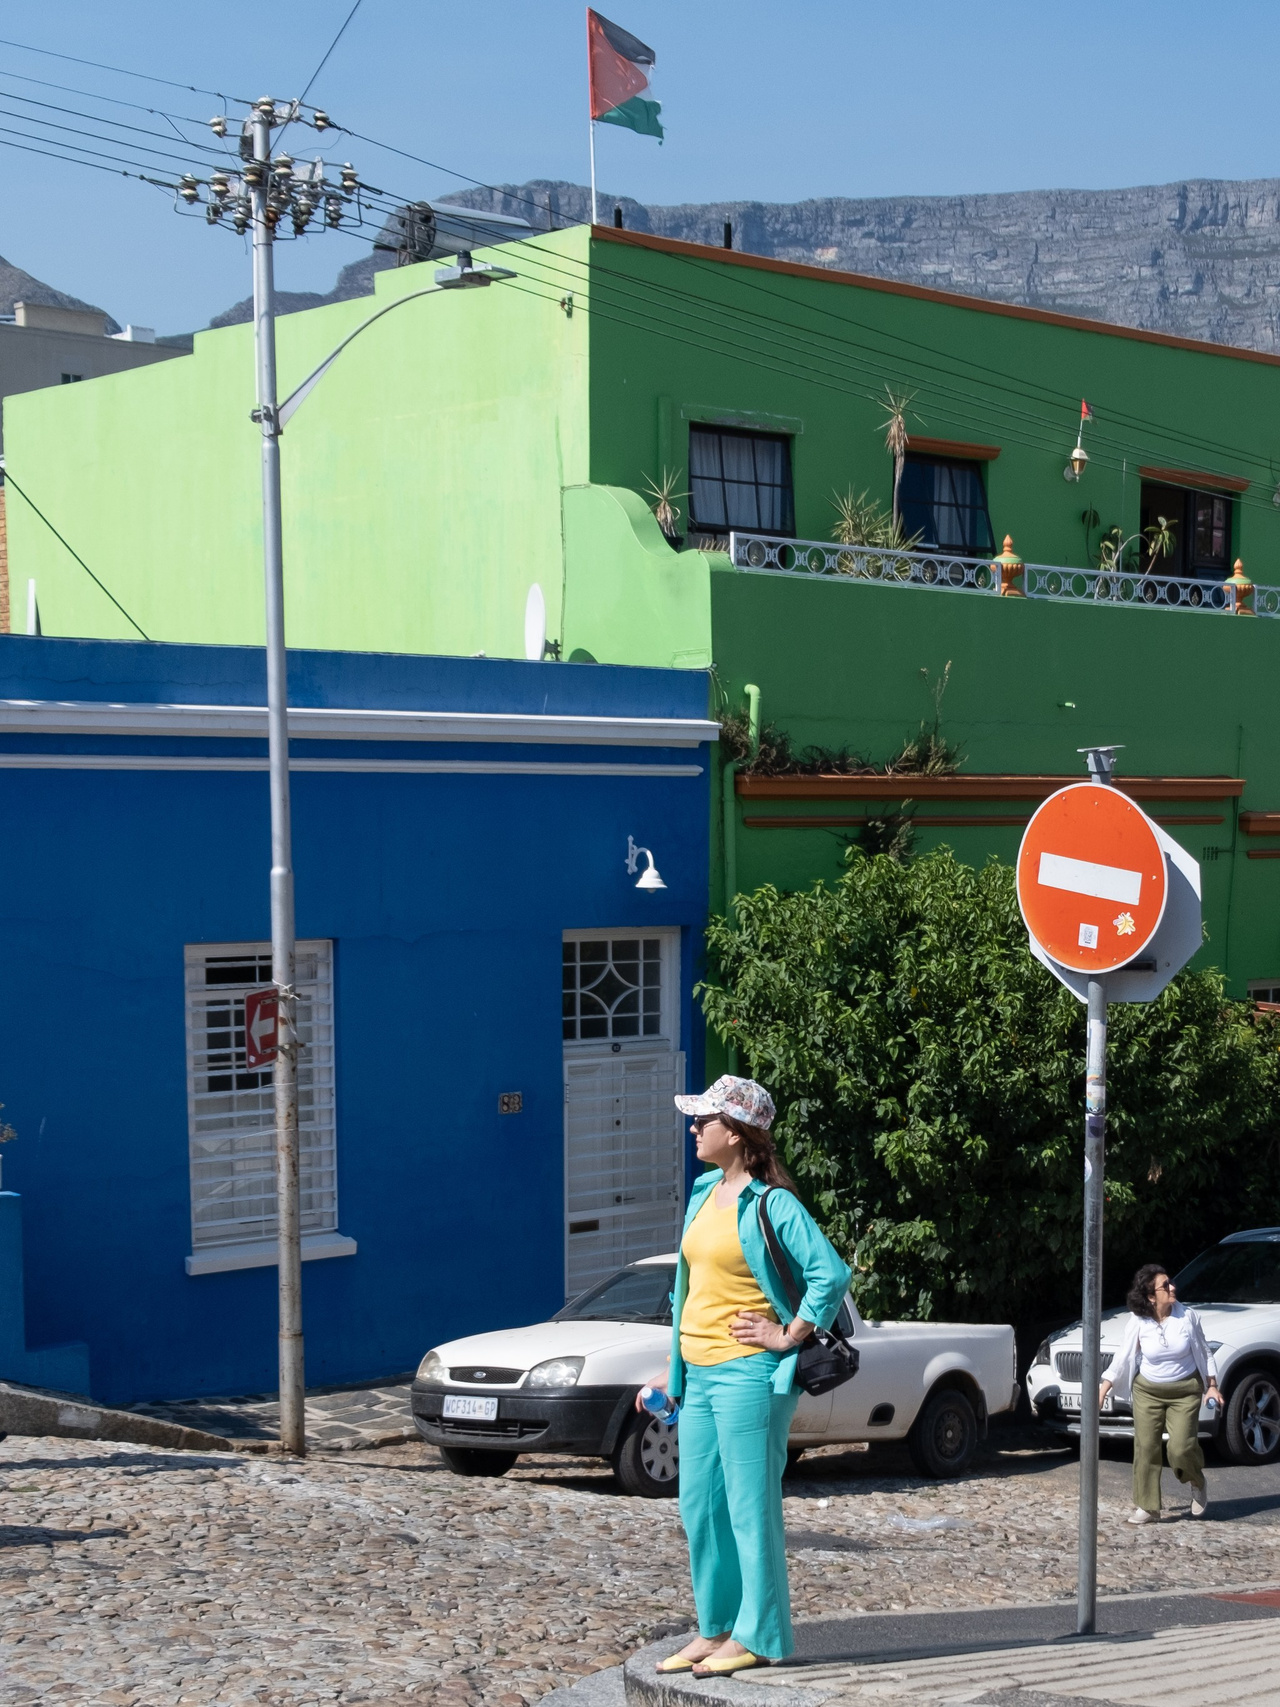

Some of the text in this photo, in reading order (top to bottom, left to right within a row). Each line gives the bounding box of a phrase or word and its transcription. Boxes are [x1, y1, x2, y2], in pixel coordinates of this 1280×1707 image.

[502, 1094, 521, 1112] 83
[445, 1398, 496, 1416] WCF314 GP
